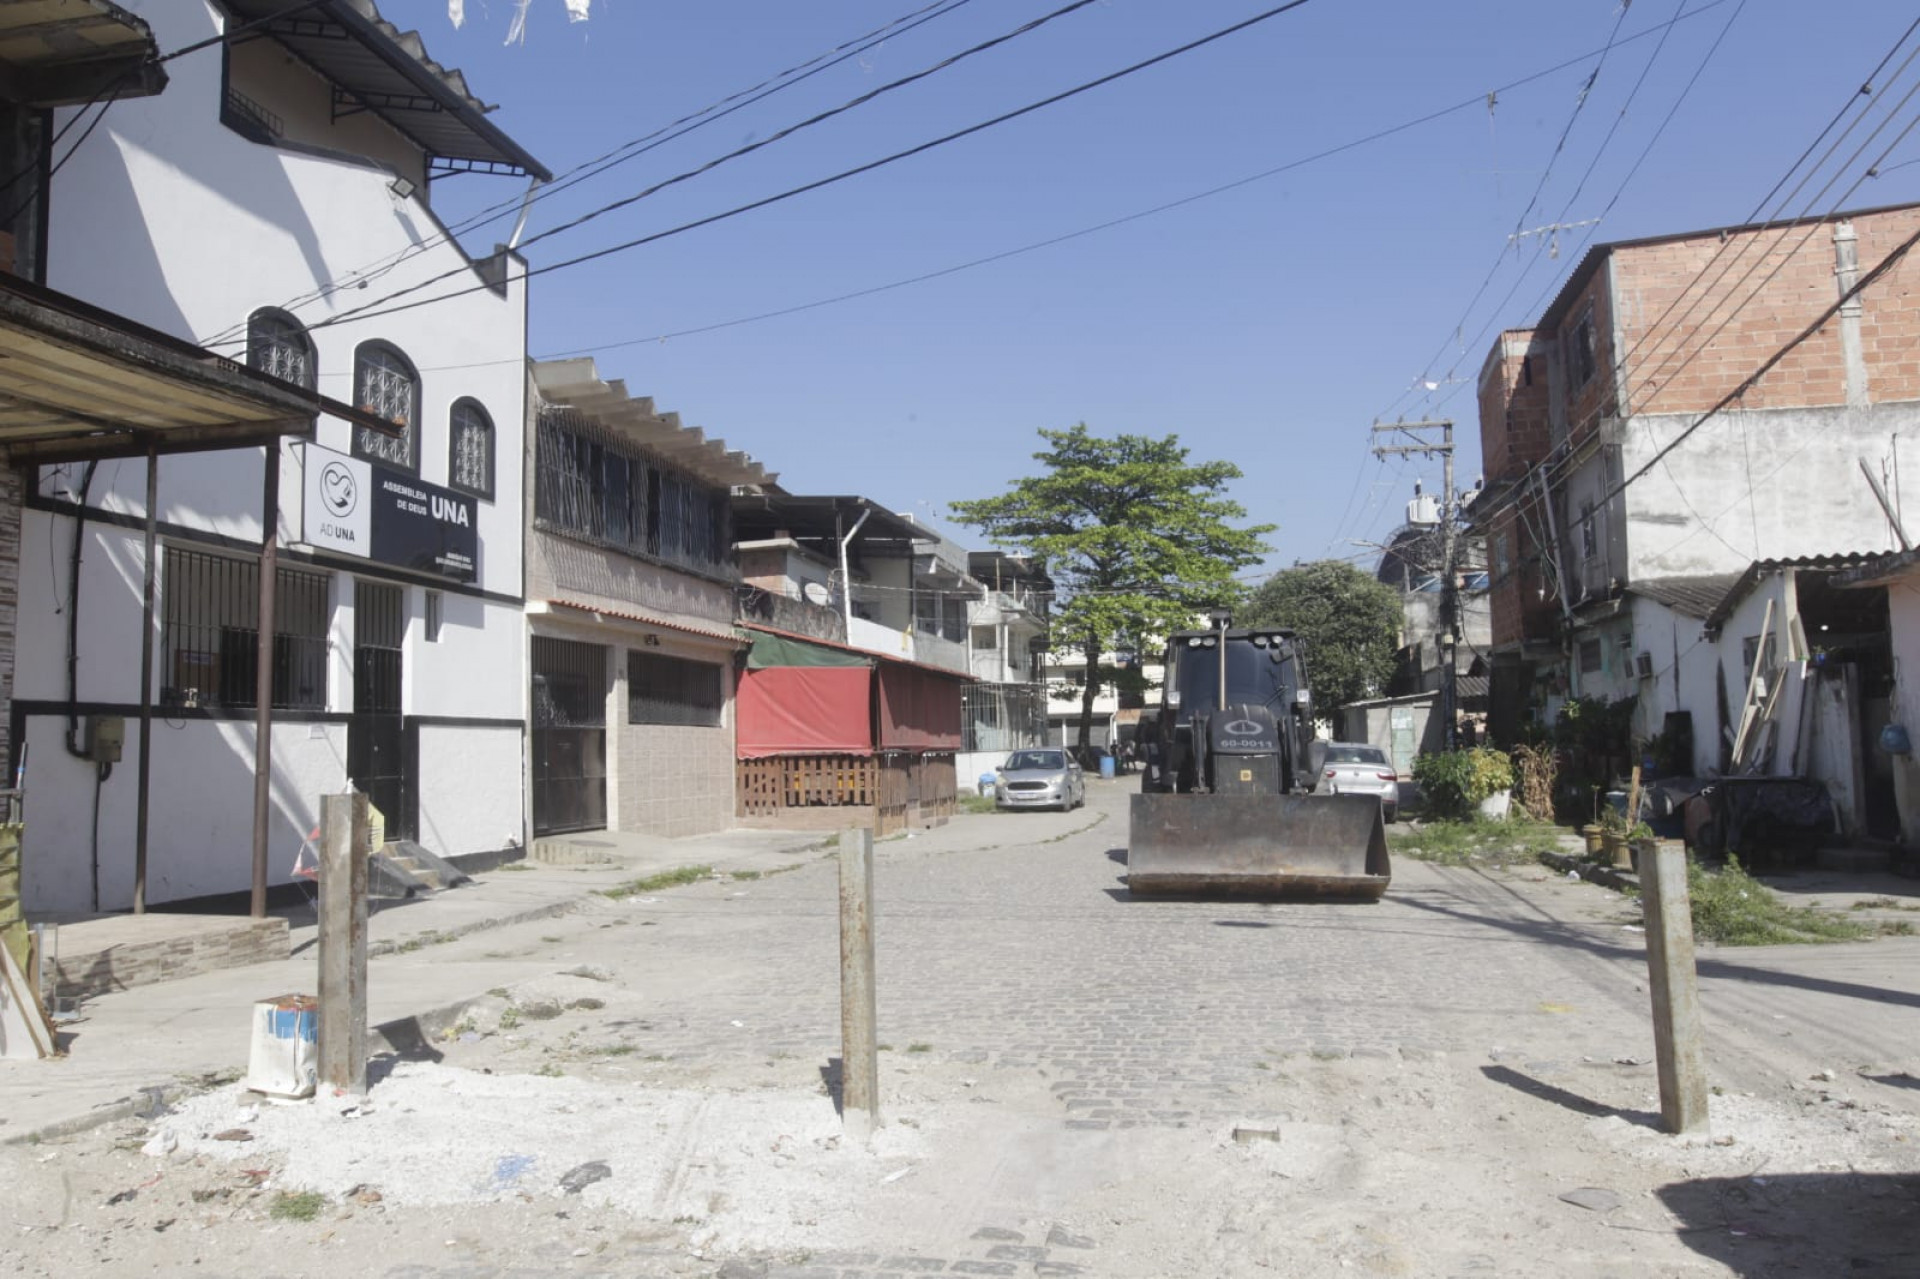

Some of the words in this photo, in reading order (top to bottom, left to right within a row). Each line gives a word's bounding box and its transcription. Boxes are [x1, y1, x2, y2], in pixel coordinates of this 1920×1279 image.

[383, 480, 427, 501] ASSEMBLEIA
[397, 499, 407, 510] DE
[408, 502, 427, 516] DEUS
[431, 495, 469, 527] UNA
[320, 523, 333, 537] AD
[335, 526, 355, 542] UNA
